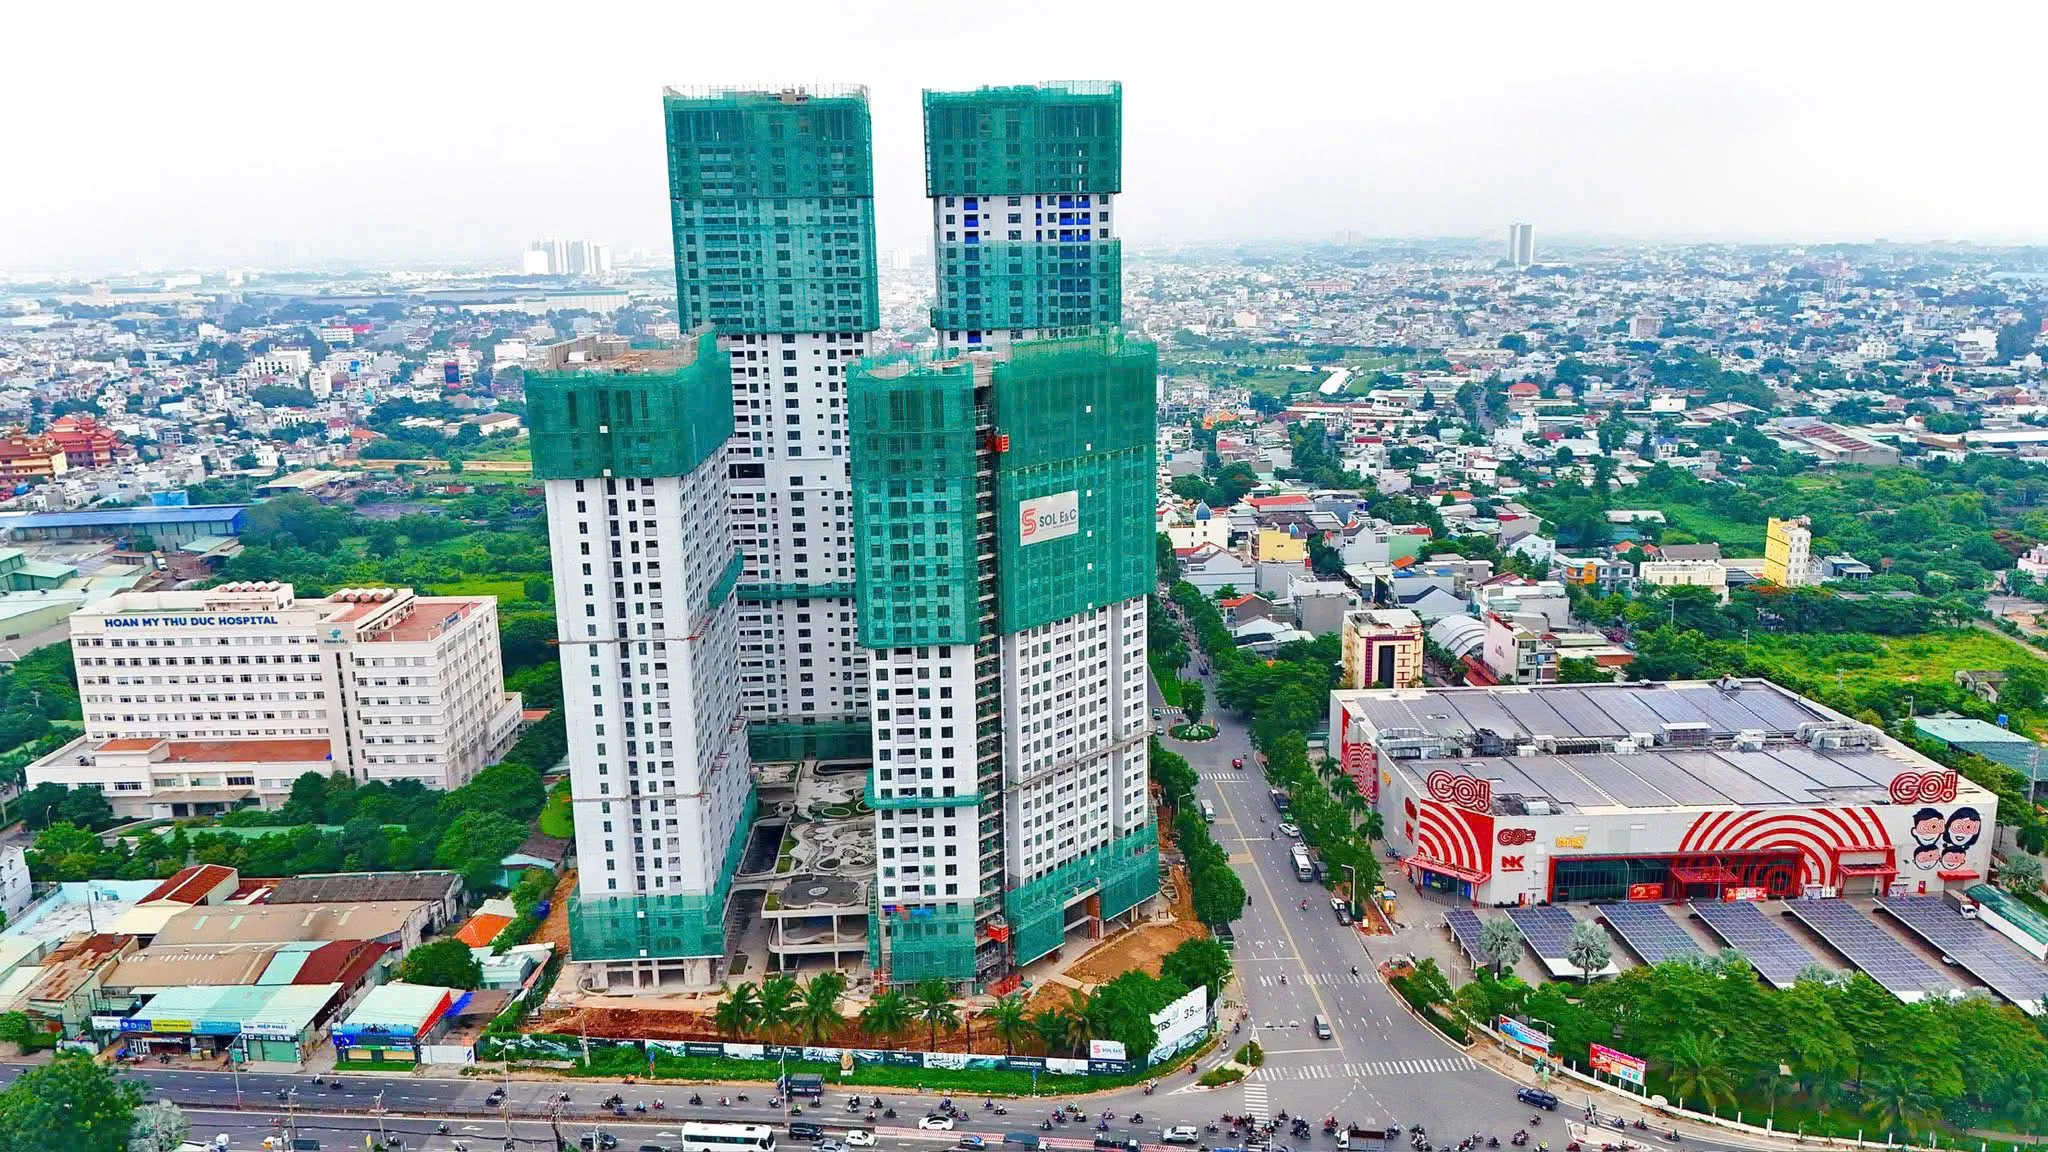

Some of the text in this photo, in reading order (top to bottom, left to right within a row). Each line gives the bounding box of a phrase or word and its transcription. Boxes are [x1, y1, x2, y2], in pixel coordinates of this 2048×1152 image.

[1040, 513, 1057, 527] SOL
[1060, 509, 1077, 523] E&C
[104, 615, 278, 628] HOAN MY THU DUC HOSPITAL
[1427, 769, 1491, 813] GO!
[1889, 770, 1958, 804] GO!
[1497, 828, 1536, 846] GO!
[1501, 855, 1525, 869] NK
[1184, 1005, 1195, 1019] 35
